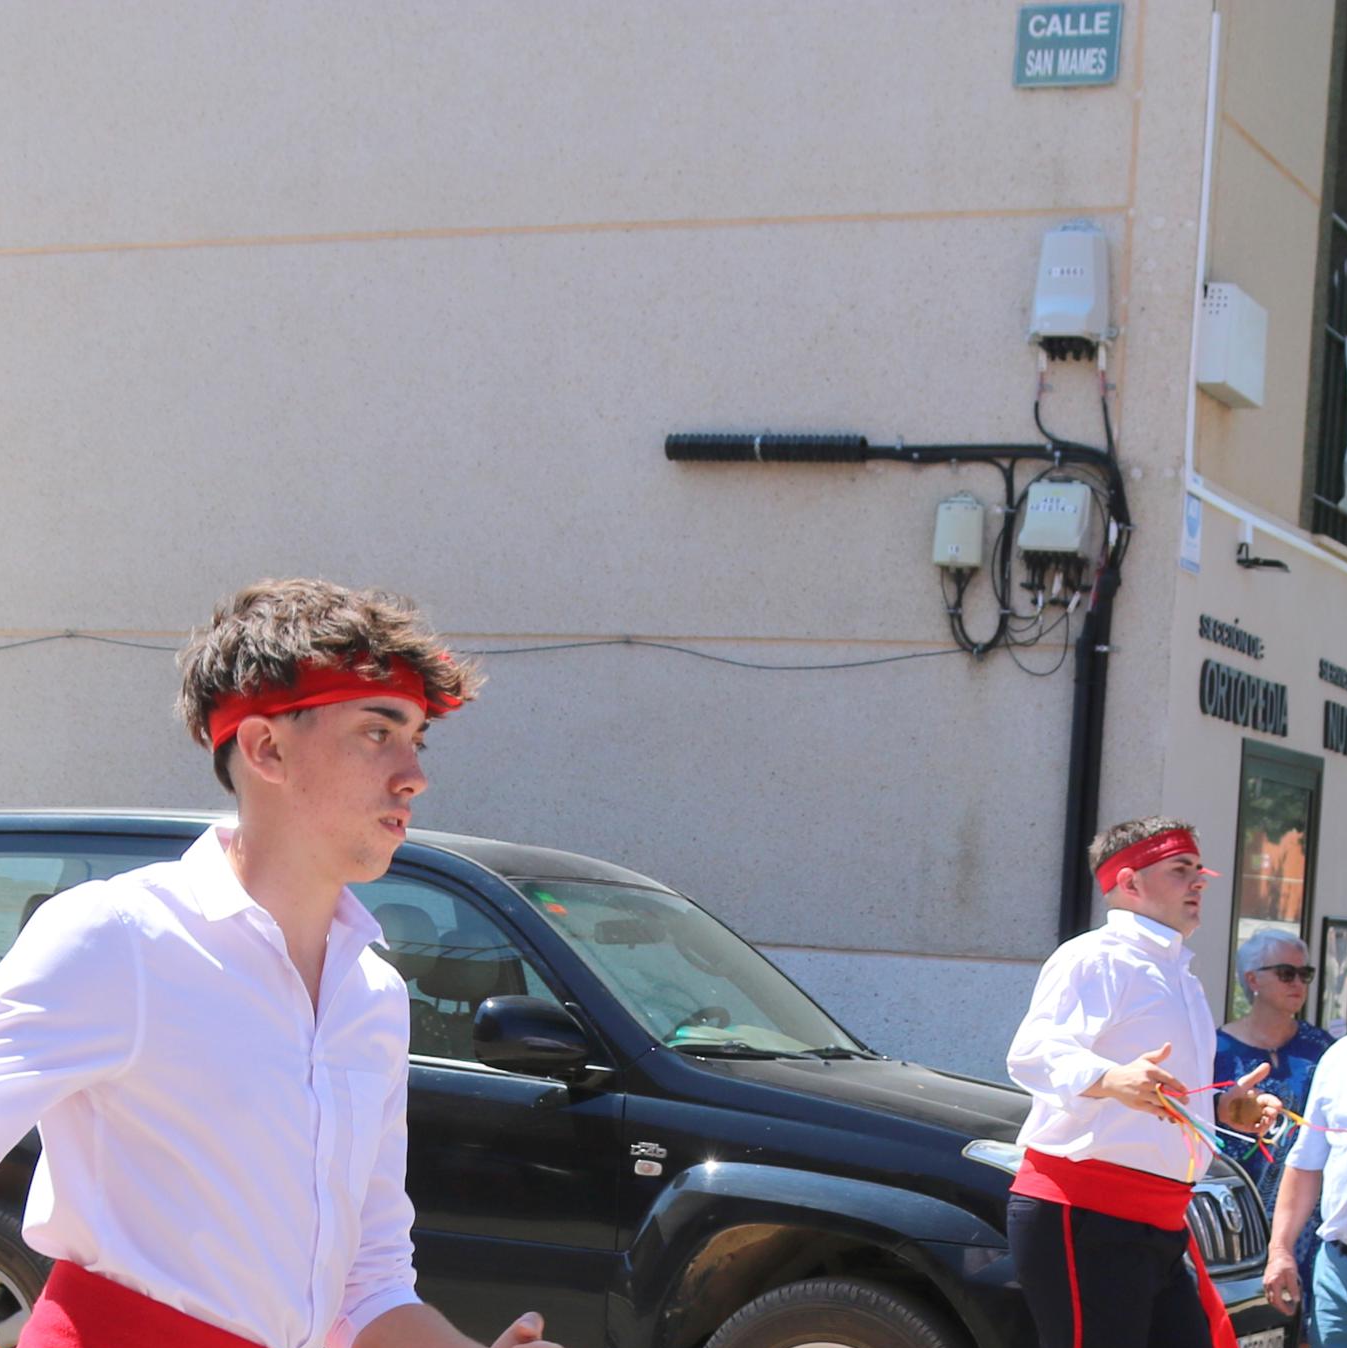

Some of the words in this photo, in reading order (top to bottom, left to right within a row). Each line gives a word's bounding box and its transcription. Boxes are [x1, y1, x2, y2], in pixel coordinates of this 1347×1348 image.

[1028, 12, 1111, 37] CALLE
[1025, 49, 1054, 77] SAN
[1057, 47, 1107, 75] MAMES
[1199, 659, 1288, 737] ORTOPEDIA
